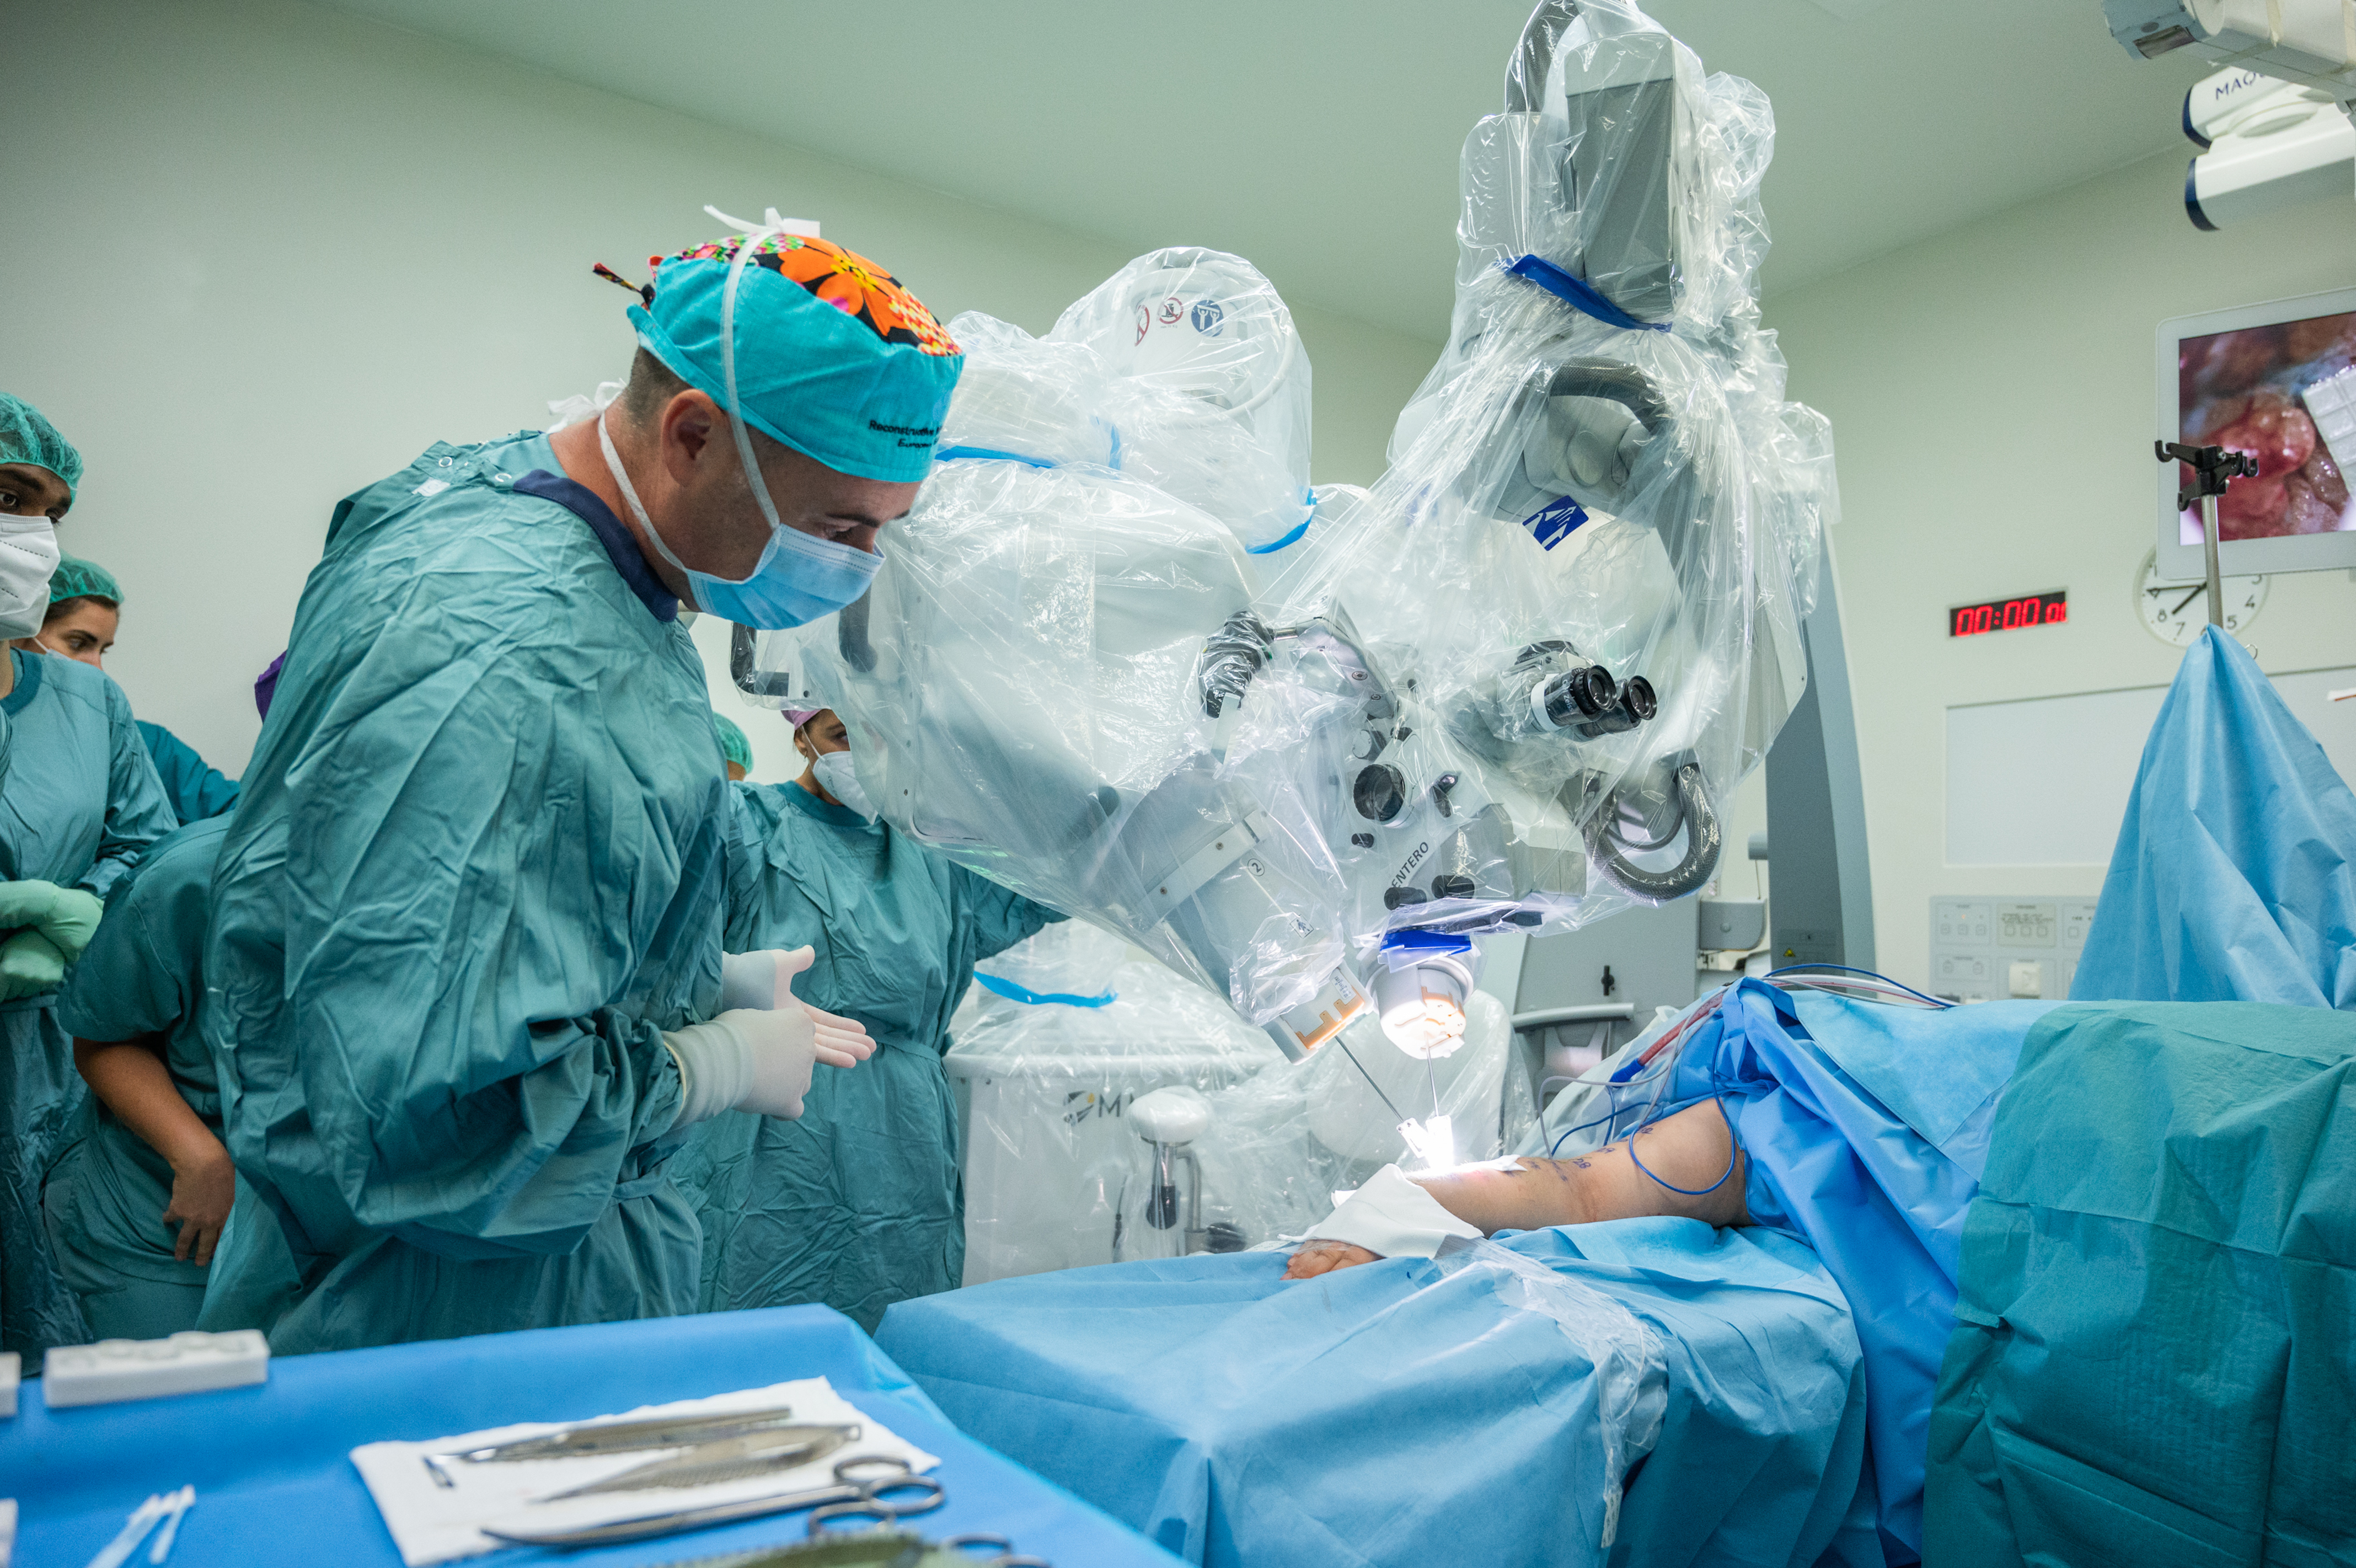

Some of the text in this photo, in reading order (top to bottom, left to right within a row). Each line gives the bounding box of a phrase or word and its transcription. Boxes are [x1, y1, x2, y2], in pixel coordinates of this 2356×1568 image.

[2215, 71, 2264, 100] MAQ
[2244, 594, 2256, 609] 4
[1955, 597, 2041, 637] 00:00
[2157, 609, 2167, 623] 8
[2226, 614, 2237, 630] 5
[2176, 621, 2186, 636] 7
[1251, 862, 1262, 873] 2
[1572, 1158, 1591, 1169] 28
